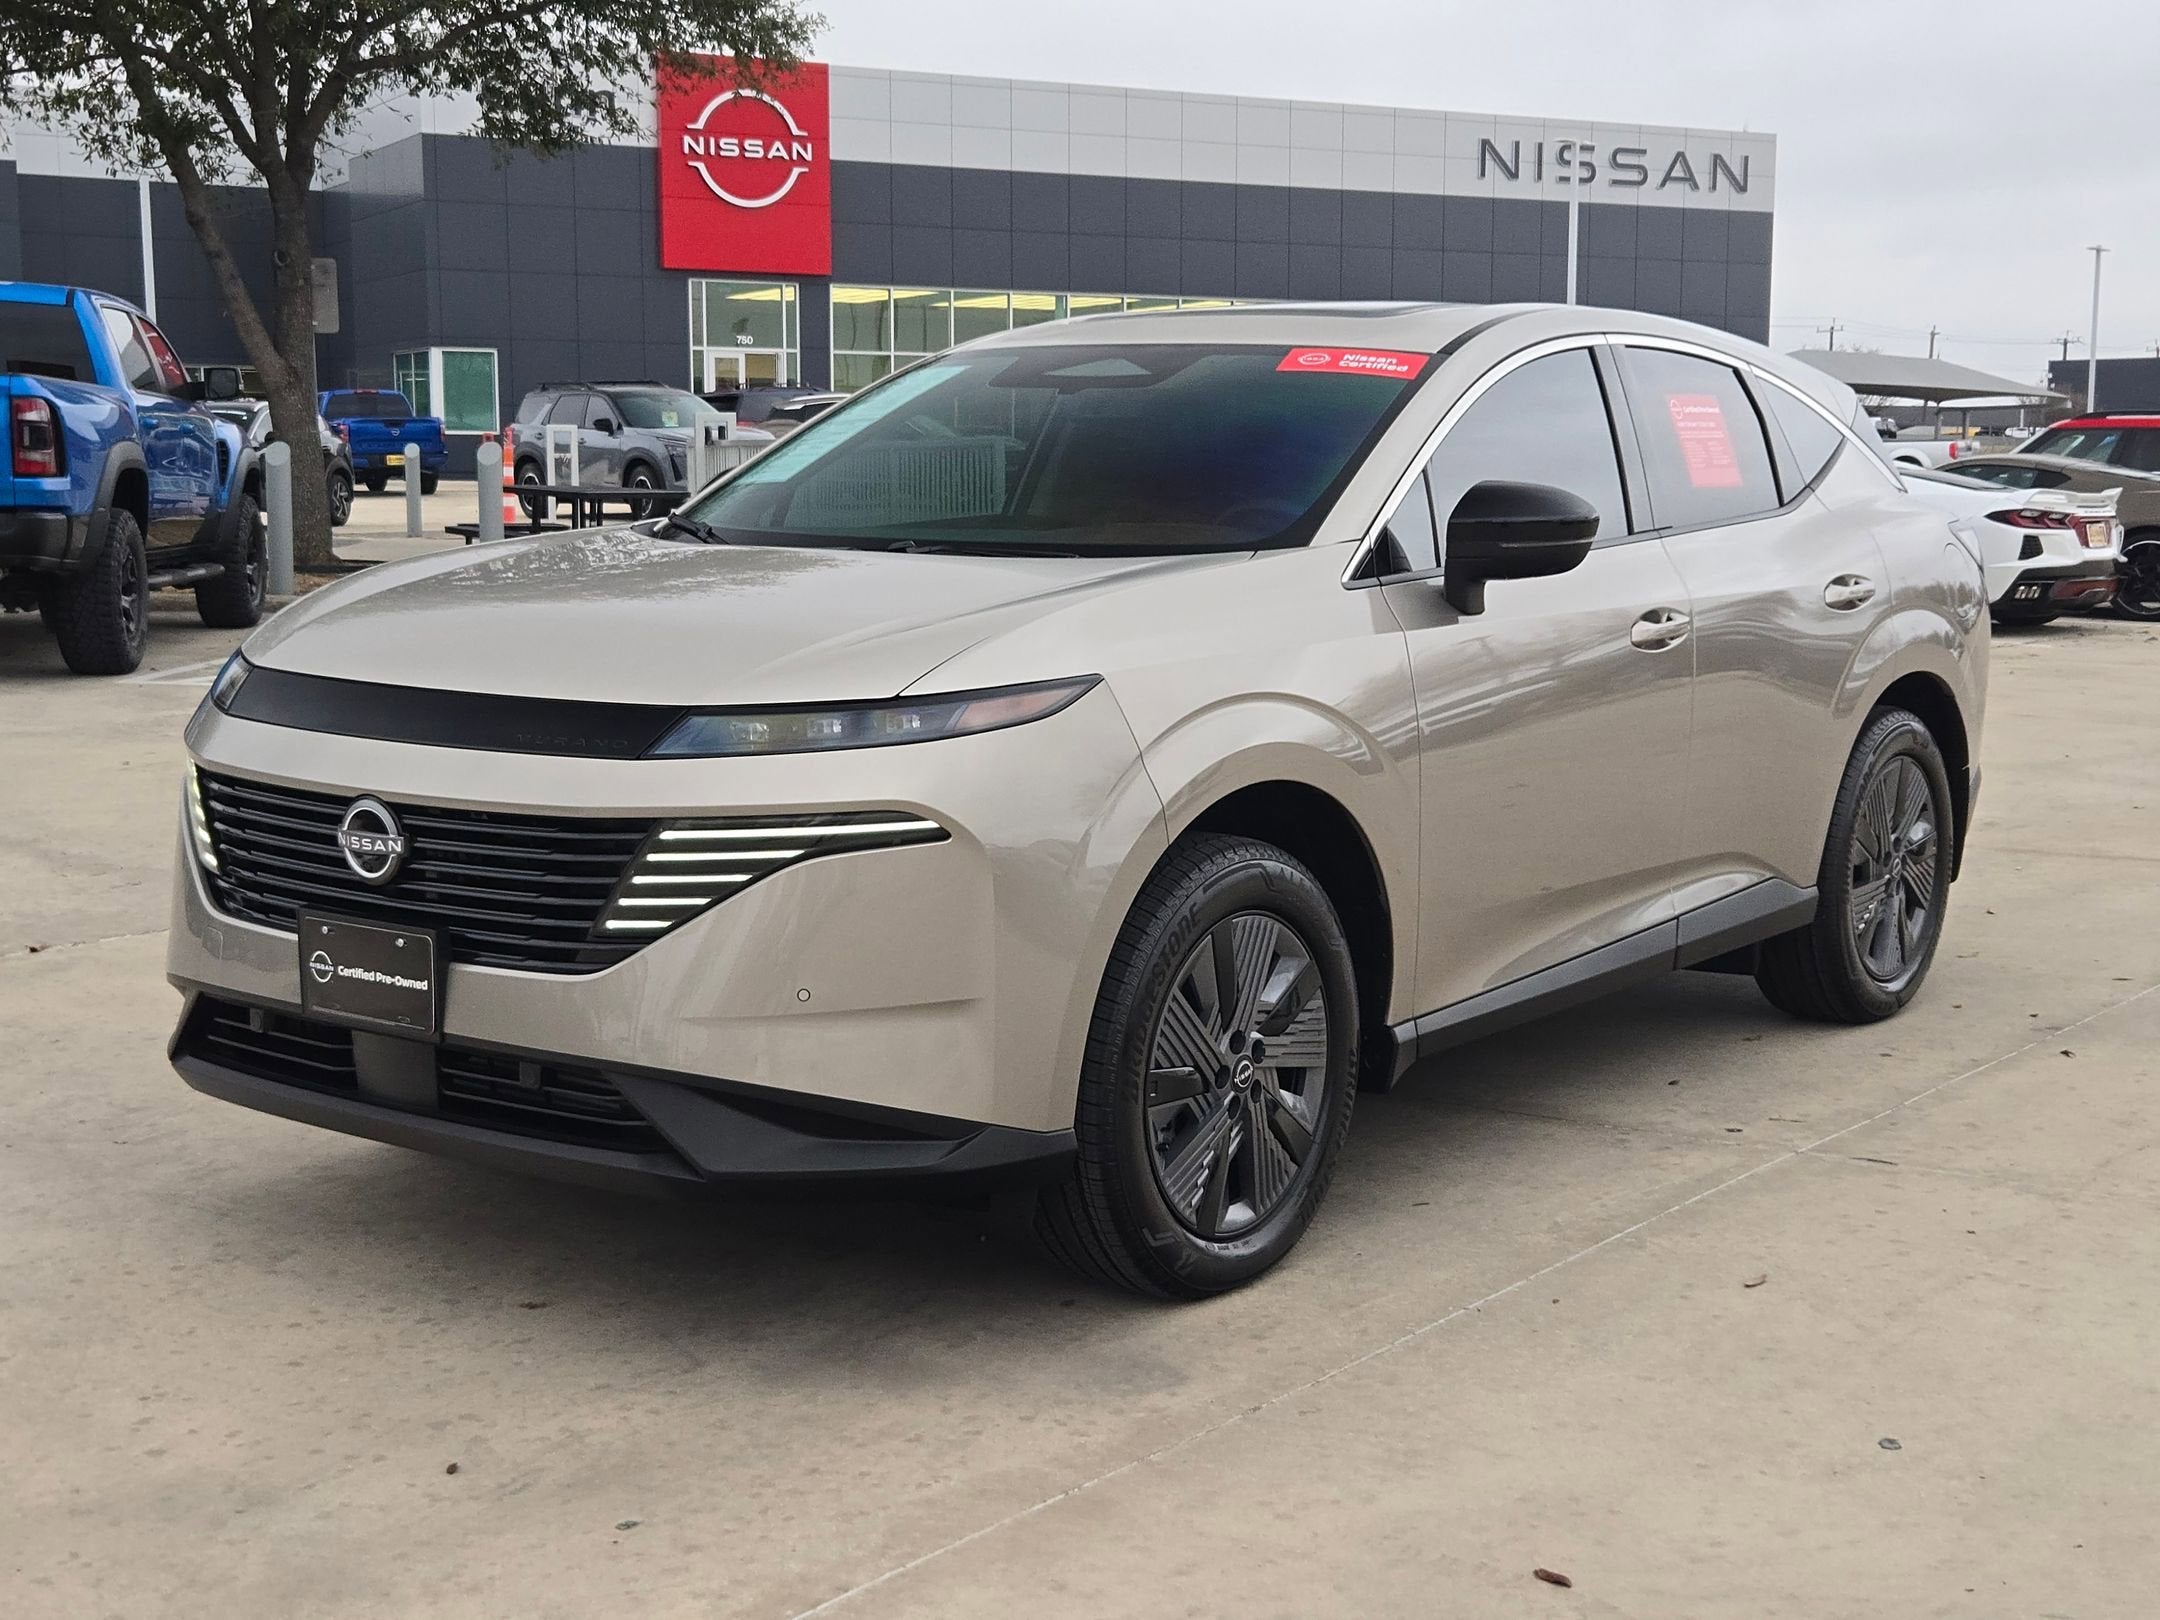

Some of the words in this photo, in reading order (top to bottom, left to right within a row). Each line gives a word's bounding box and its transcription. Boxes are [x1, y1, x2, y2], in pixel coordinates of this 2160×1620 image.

[682, 135, 812, 162] NISSAN
[1477, 138, 1750, 194] NISSAN
[1338, 361, 1409, 373] Certified
[1342, 353, 1398, 365] Nissan
[338, 831, 402, 852] NISSAN
[337, 965, 375, 982] Certified
[376, 972, 428, 991] Pre-Owned
